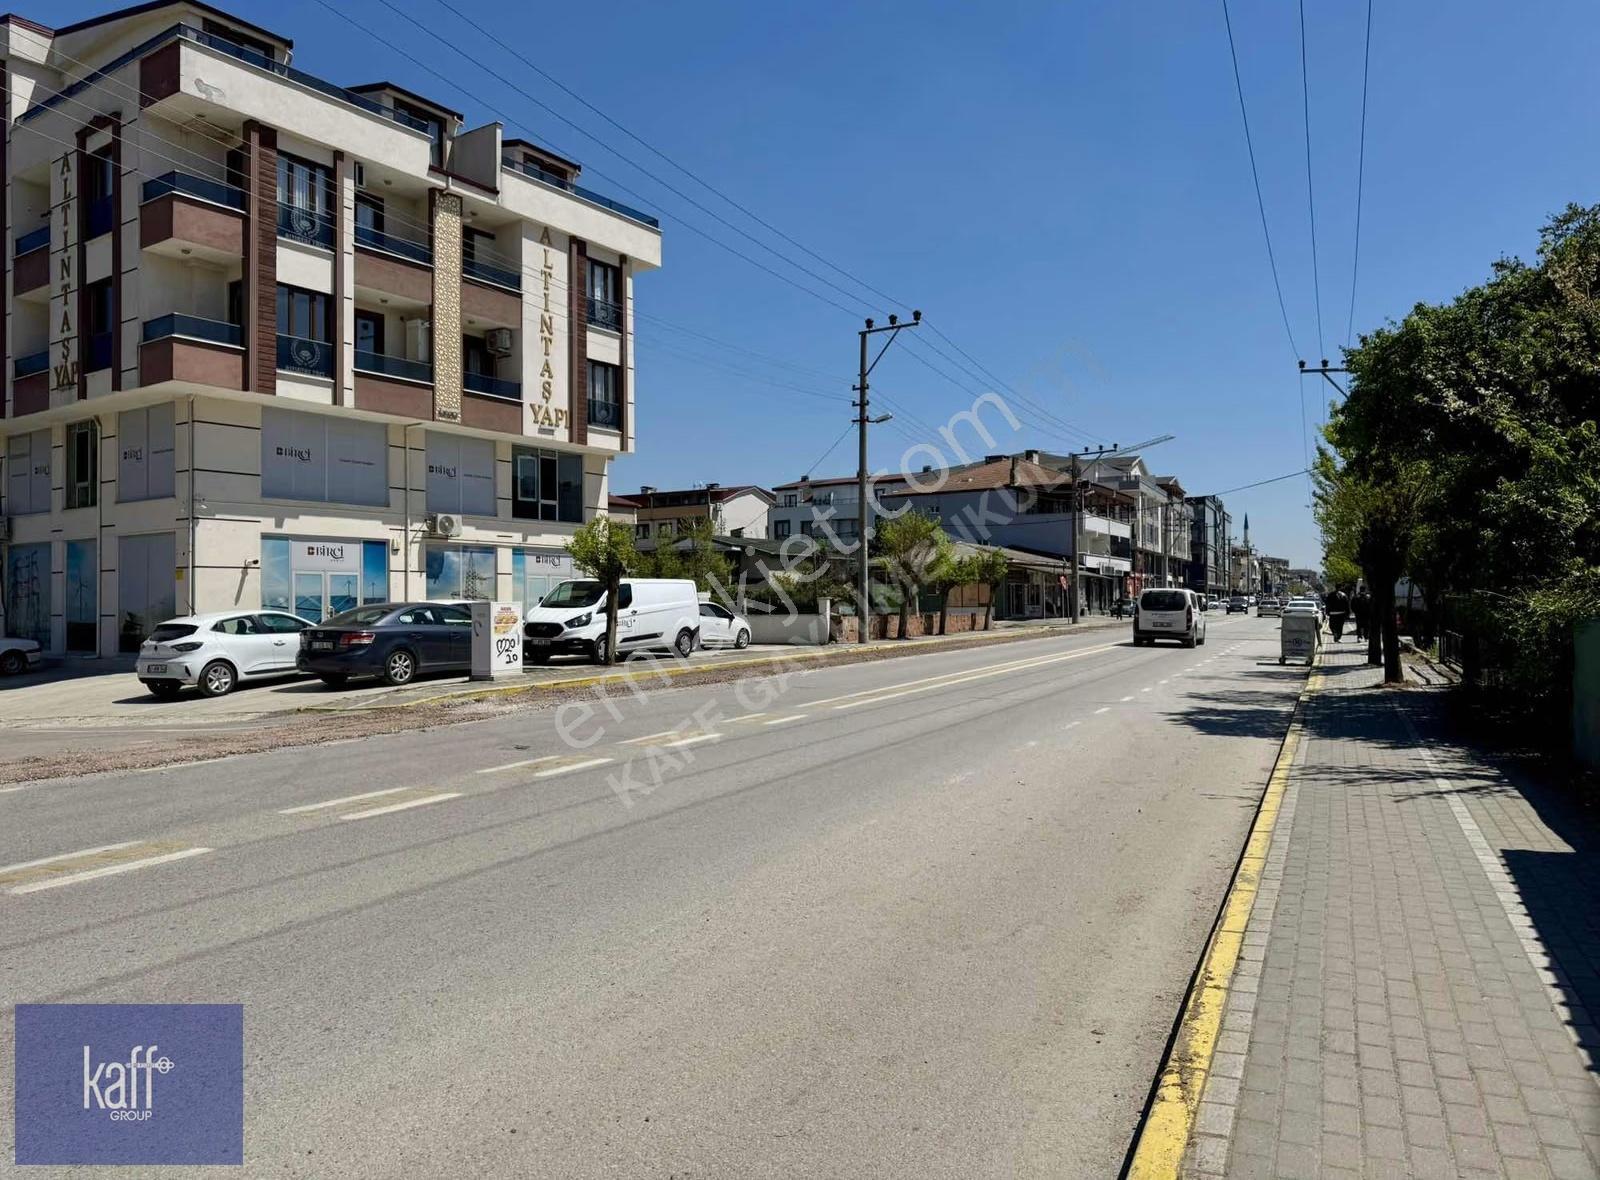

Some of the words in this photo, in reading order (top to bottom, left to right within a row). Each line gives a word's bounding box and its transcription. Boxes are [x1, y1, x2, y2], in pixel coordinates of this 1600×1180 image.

[60, 152, 71, 364] ALTINTAŞ
[539, 226, 554, 404] ALTINTAŞ
[54, 361, 80, 387] YAP
